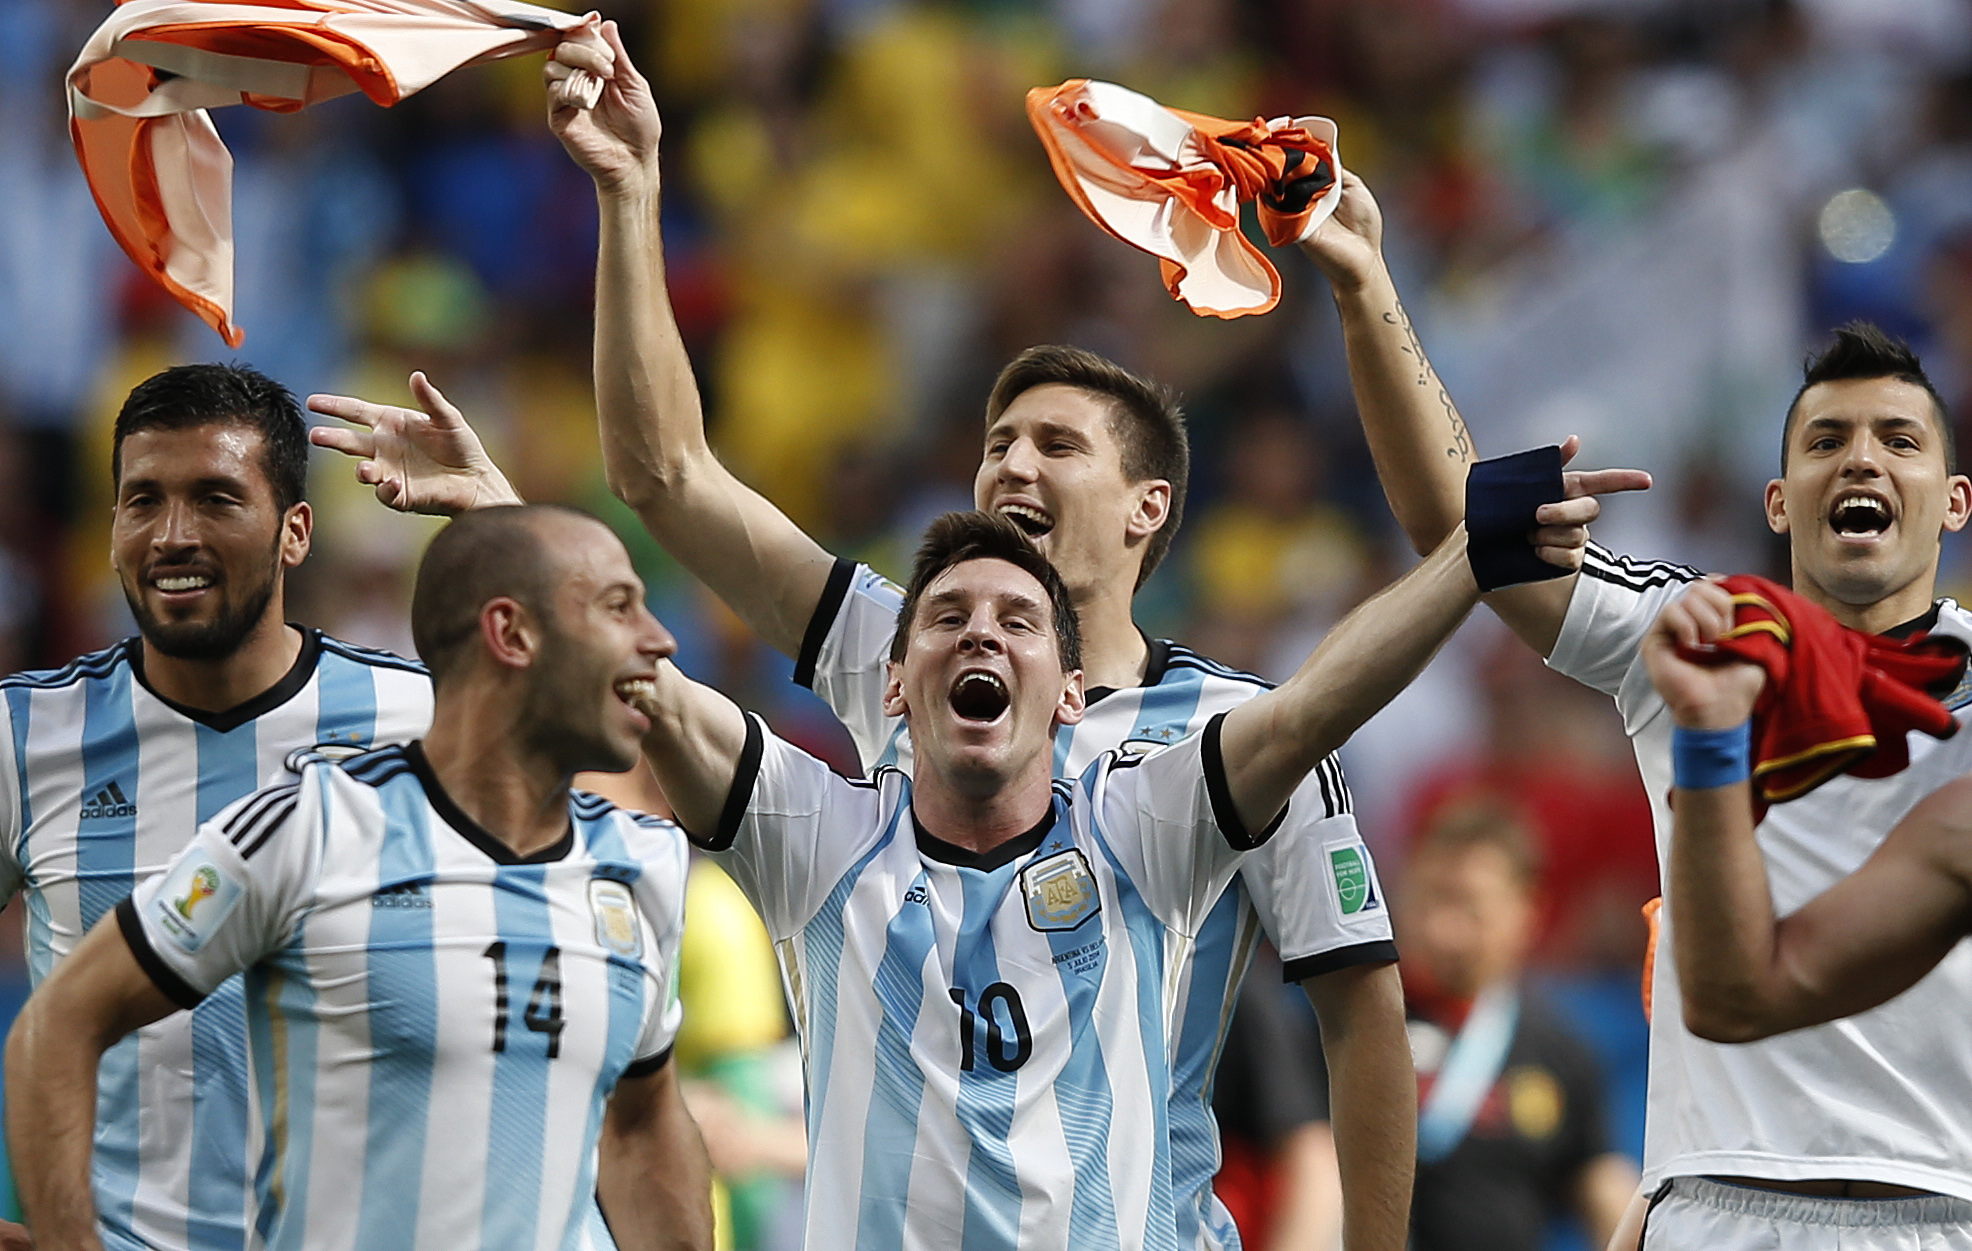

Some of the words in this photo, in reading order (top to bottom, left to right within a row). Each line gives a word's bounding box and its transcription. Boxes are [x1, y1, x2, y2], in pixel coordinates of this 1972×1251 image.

[80, 804, 137, 818] adidas
[372, 894, 433, 908] adidas
[1047, 875, 1079, 906] AFA
[483, 942, 567, 1058] 14
[949, 983, 1032, 1072] 10
